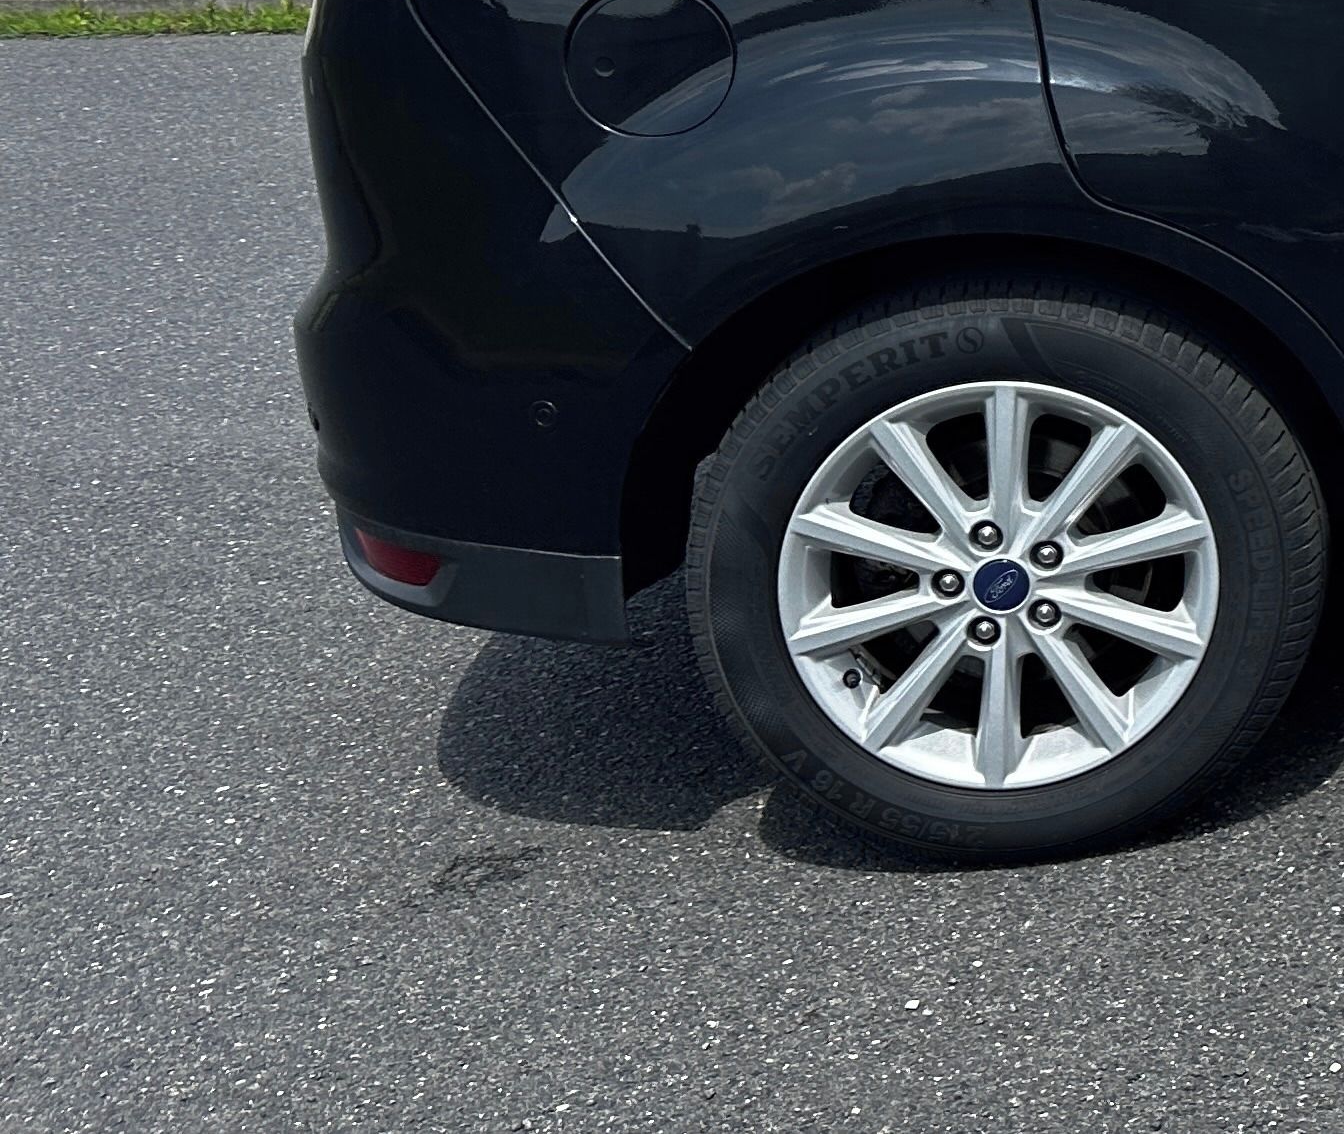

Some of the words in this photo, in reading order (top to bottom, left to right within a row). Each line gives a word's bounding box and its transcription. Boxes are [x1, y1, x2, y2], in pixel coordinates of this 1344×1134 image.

[748, 330, 949, 483] SEMPERIT
[780, 748, 808, 774] V
[810, 769, 845, 801] 16
[848, 790, 878, 820] R
